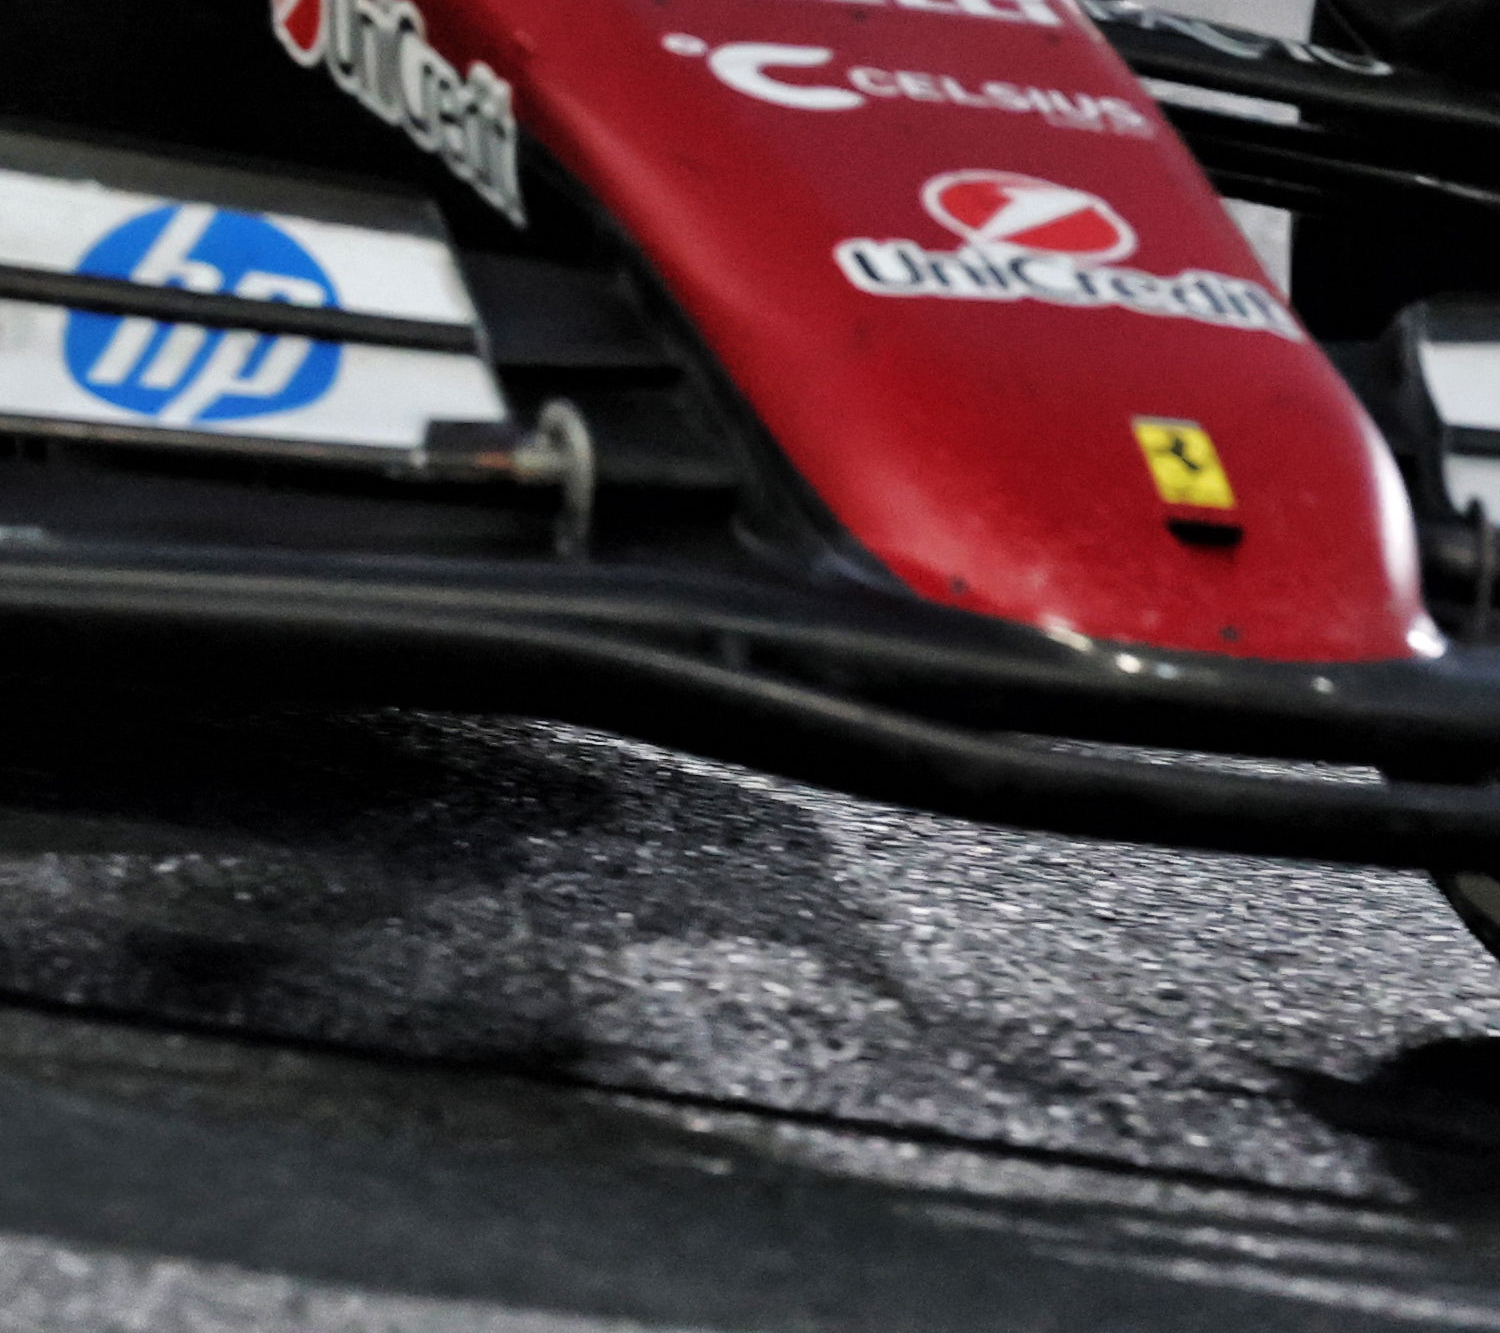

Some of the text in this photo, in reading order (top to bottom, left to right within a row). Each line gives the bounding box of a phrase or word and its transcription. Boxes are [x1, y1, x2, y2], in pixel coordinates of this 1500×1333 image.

[847, 66, 1148, 129] CELSIUS
[86, 201, 327, 425] hp
[840, 239, 1292, 337] UniCredit
